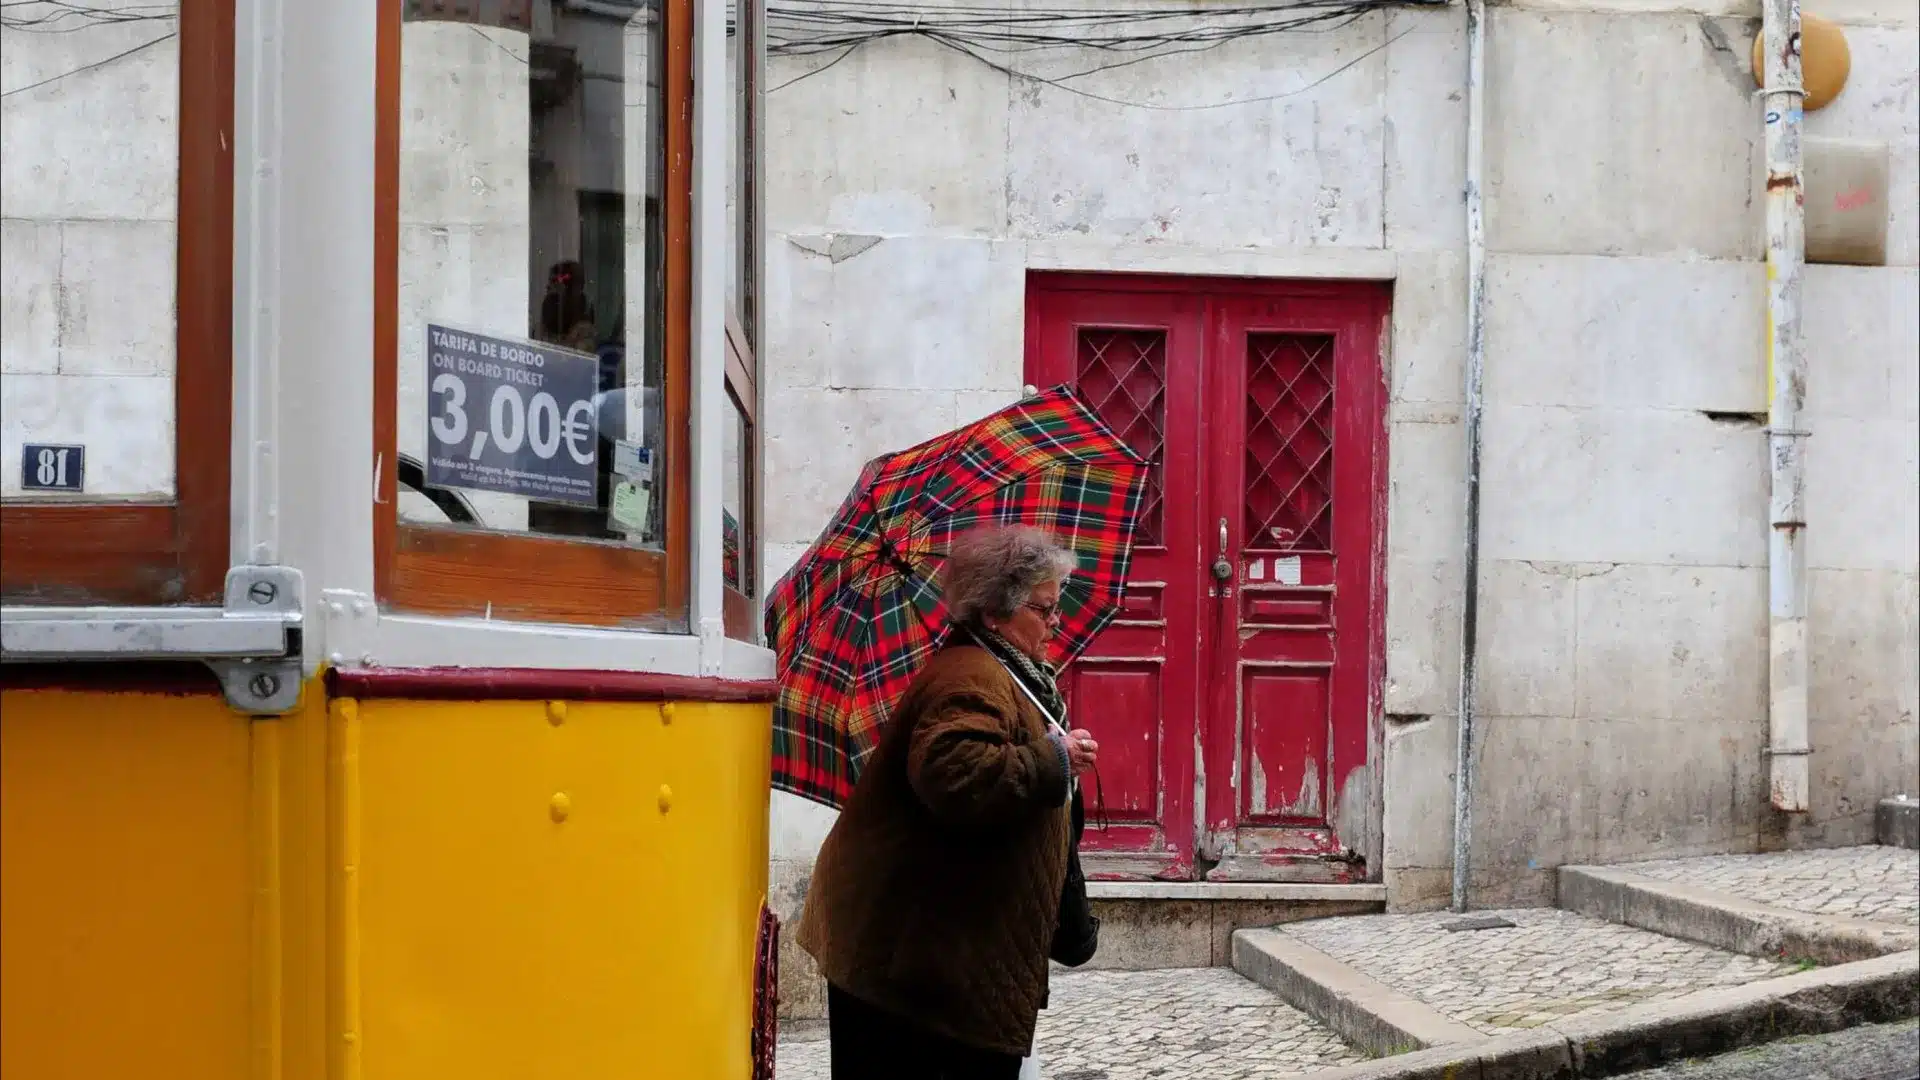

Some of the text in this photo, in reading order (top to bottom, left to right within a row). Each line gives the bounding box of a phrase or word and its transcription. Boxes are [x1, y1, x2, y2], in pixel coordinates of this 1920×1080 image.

[432, 331, 545, 368] TARIFA DE BORDO
[432, 353, 544, 387] ON BOARD TICKET
[431, 373, 595, 465] 3,00€
[37, 448, 69, 486] 81
